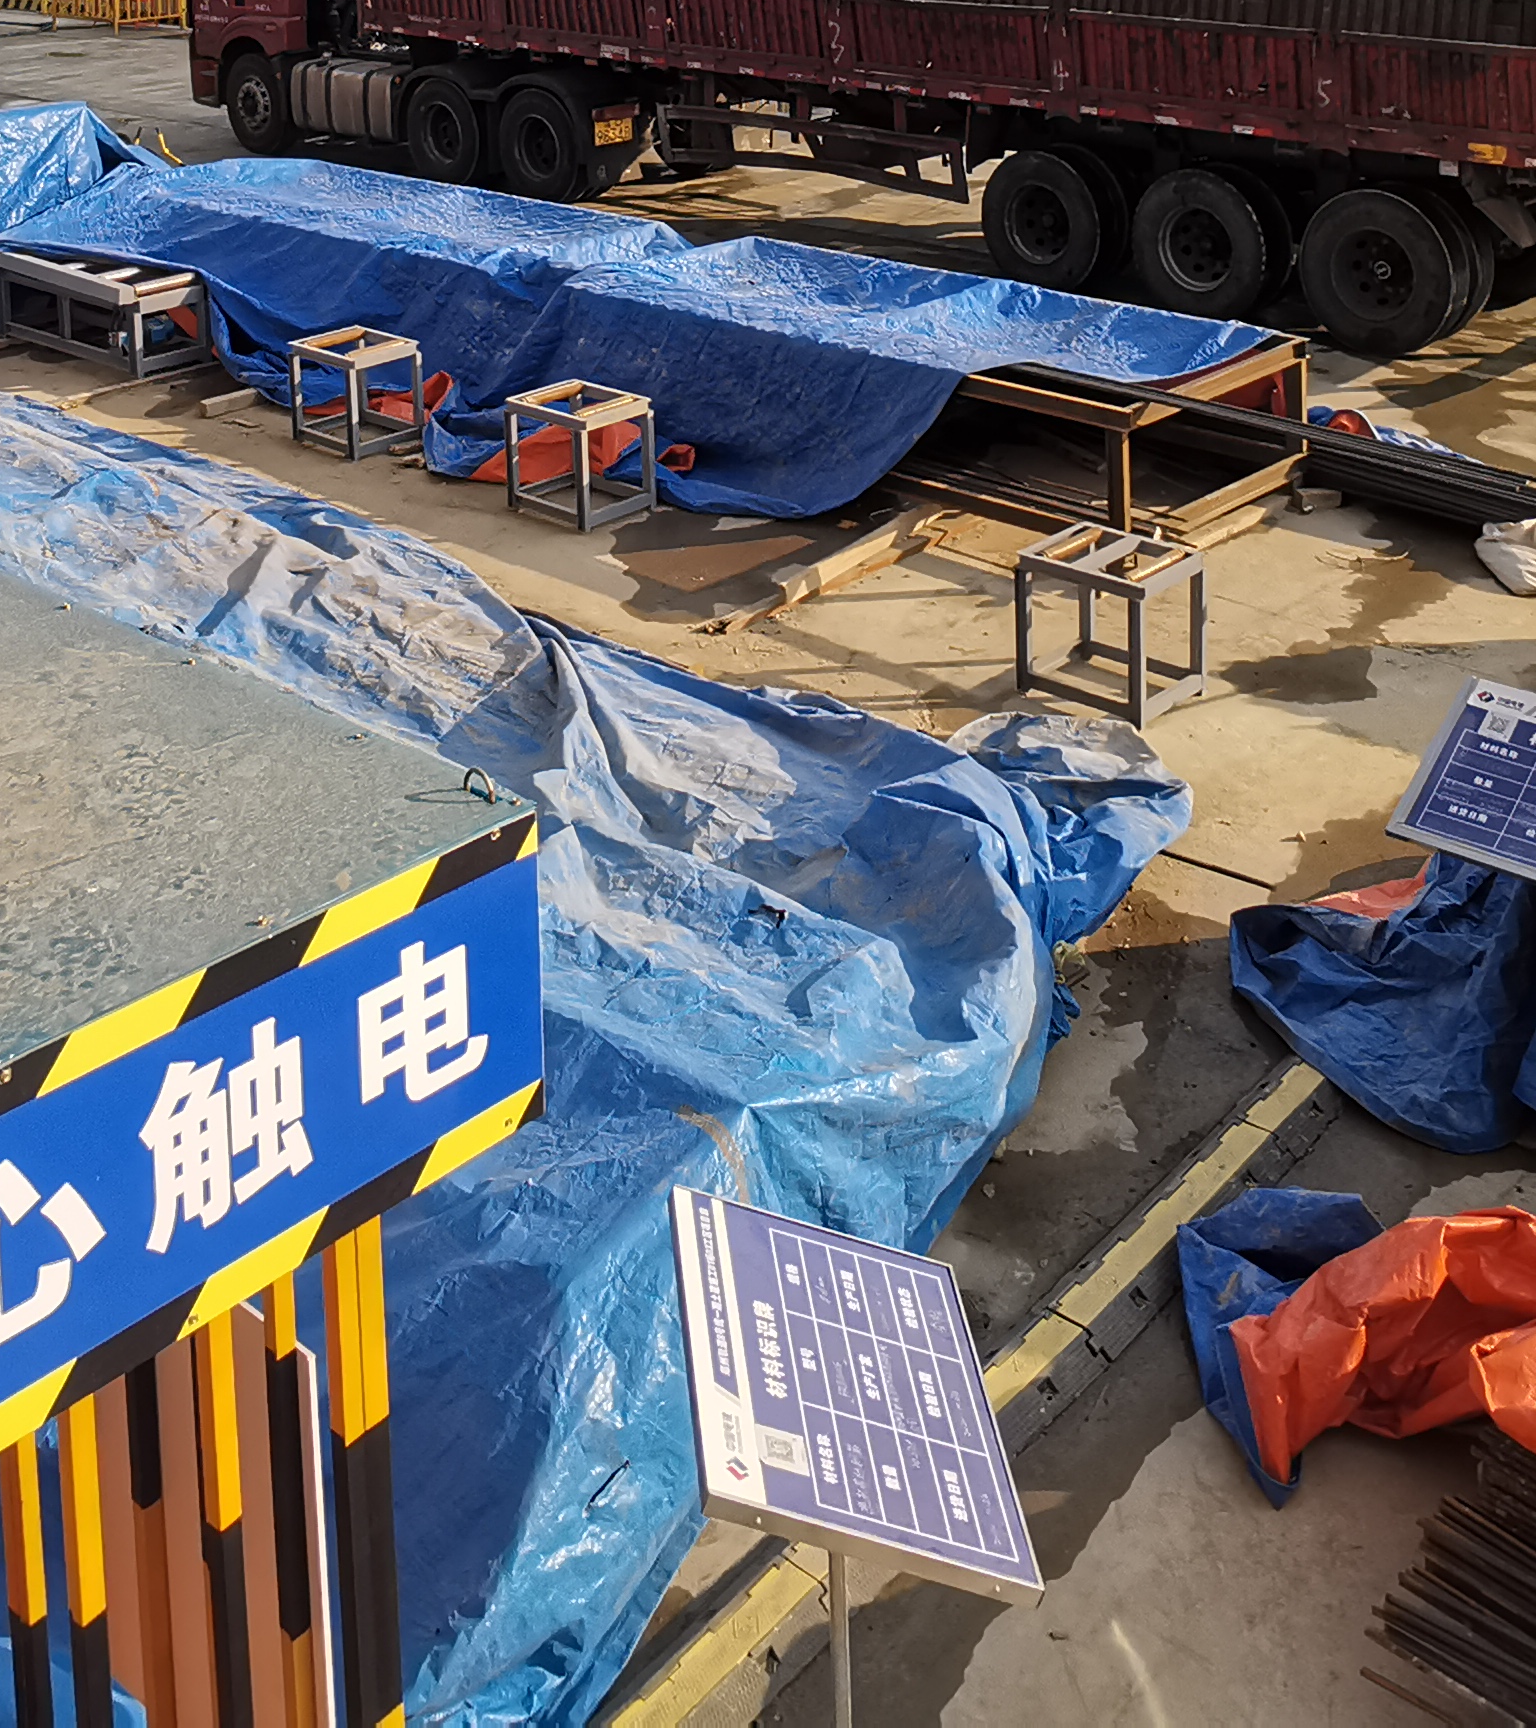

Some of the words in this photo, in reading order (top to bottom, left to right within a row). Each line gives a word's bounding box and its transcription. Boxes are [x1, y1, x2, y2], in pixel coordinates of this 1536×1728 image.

[840, 1269, 862, 1313] 生产日期
[897, 1286, 919, 1329] 检验状态
[752, 1299, 789, 1400] 材料标识牌
[858, 1353, 882, 1401] 生产厂家
[918, 1370, 942, 1418] 检验日期
[816, 1432, 839, 1485] 材料名称
